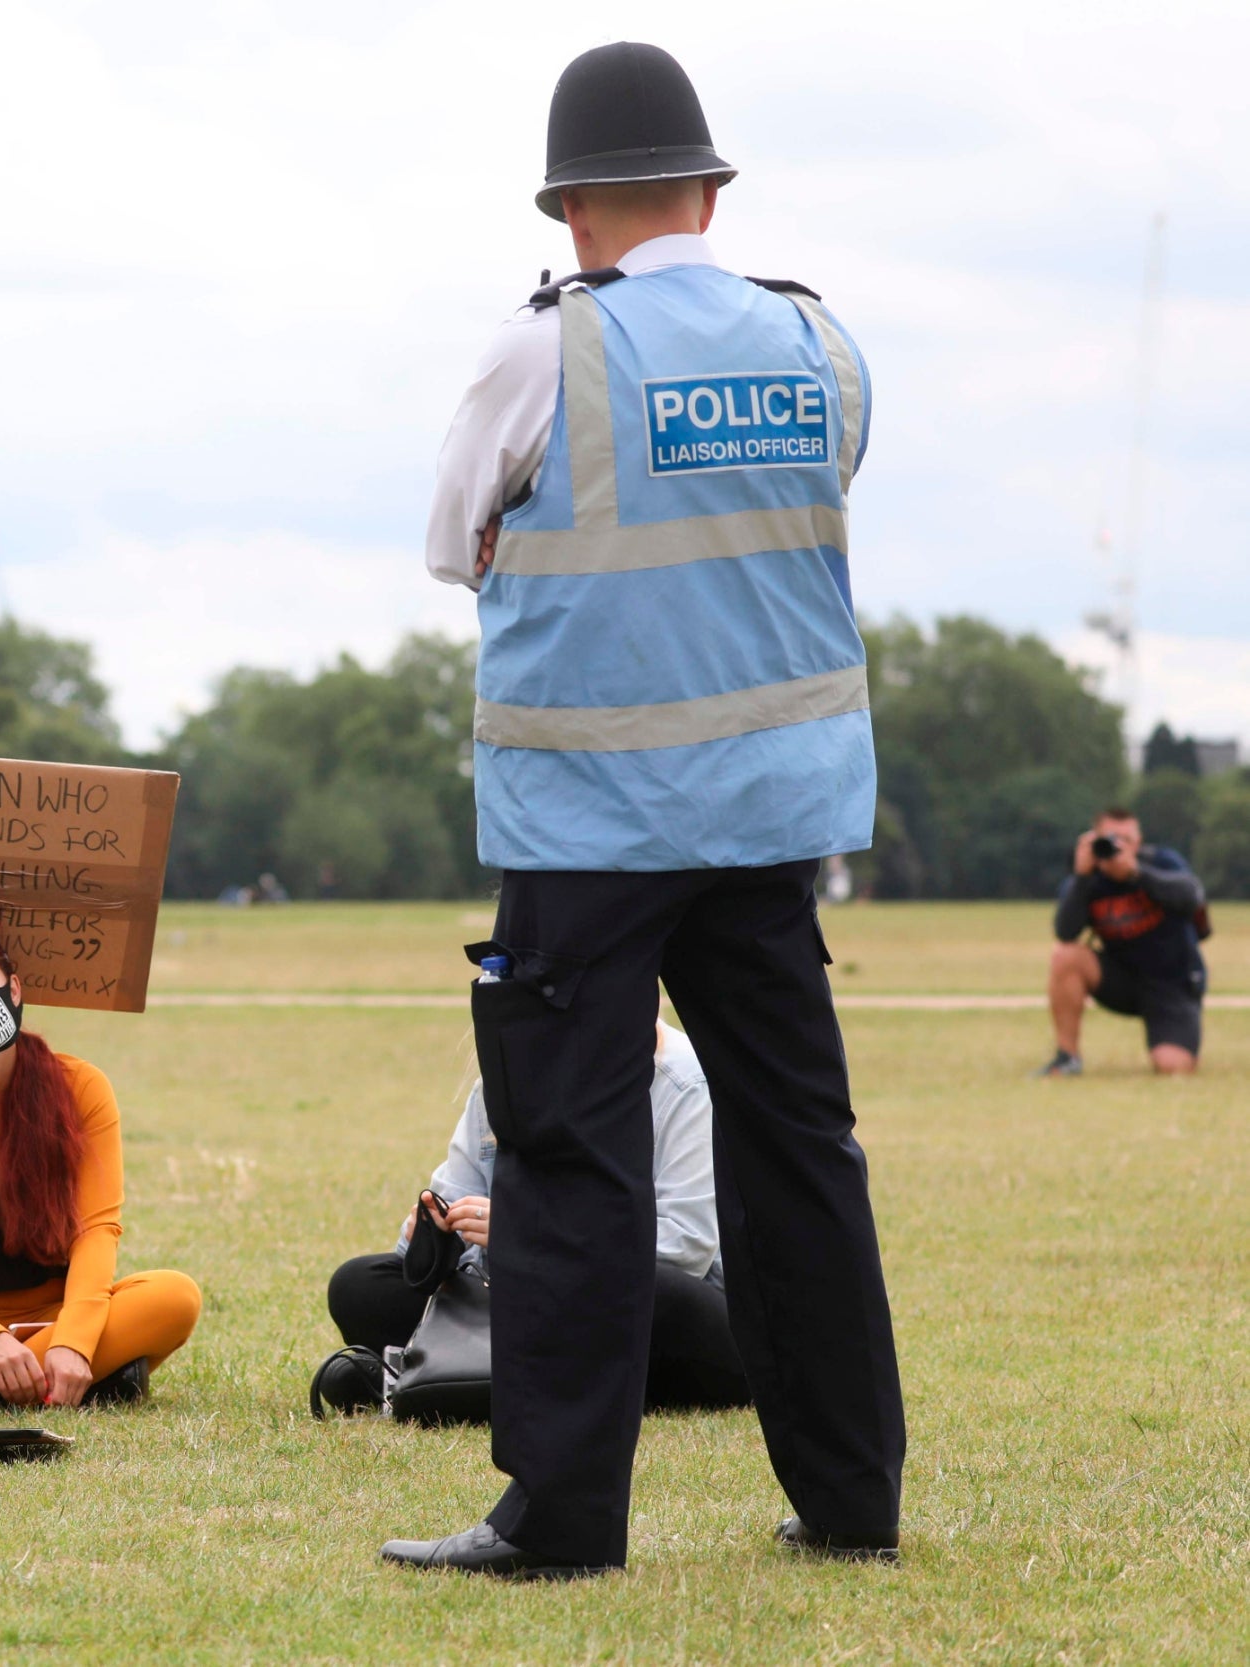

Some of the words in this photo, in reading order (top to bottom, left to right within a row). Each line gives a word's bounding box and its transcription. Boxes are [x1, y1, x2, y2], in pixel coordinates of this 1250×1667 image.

[653, 383, 823, 432] POLICE
[658, 440, 741, 465] LIAISON
[745, 437, 824, 458] OFFICER
[37, 775, 109, 814] WHO
[62, 827, 126, 859] FOR
[48, 910, 105, 936] FOR
[95, 975, 117, 997] X
